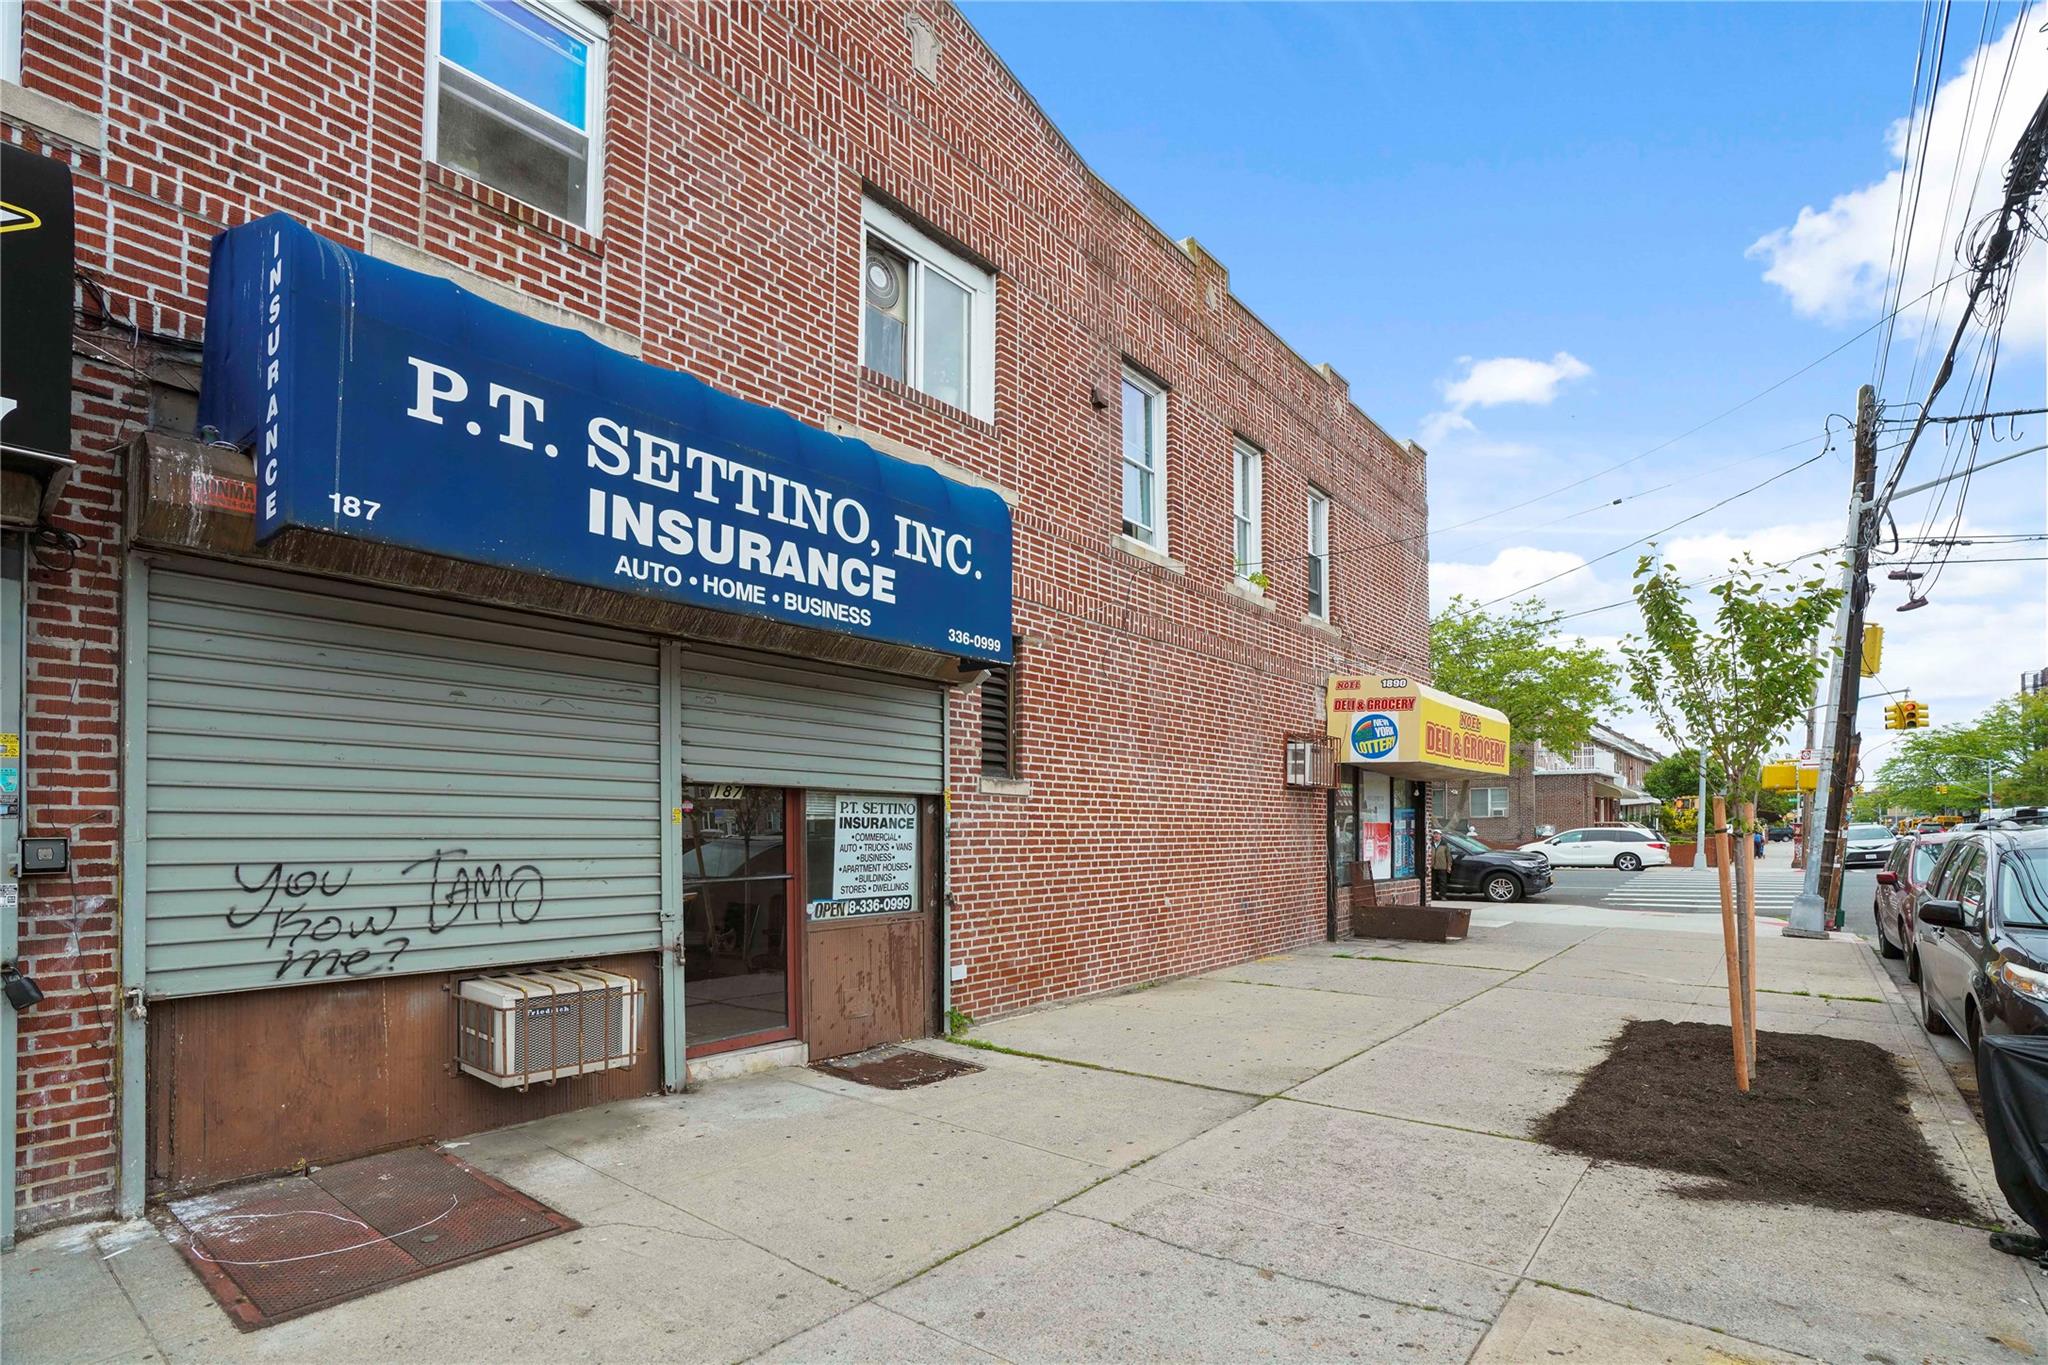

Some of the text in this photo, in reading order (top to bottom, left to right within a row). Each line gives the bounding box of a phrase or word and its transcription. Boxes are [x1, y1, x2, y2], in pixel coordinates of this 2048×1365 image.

[265, 231, 283, 521] INSURANCE
[407, 356, 983, 580] P.T. SETTINO, INC.
[328, 493, 381, 521] 187
[588, 488, 897, 604] INSURANCE
[614, 555, 872, 627] AUTO HOME BUSINESS
[948, 628, 1001, 652] 336-0999
[1336, 679, 1407, 690] NOEL 1890
[1333, 697, 1416, 712] DELI & GROCERY
[1373, 719, 1390, 727] NEW
[1459, 711, 1481, 732] NOEL
[1374, 727, 1395, 738] YORK
[1355, 736, 1396, 754] LOTTERY
[1426, 721, 1507, 768] DELI & GROCERY
[714, 785, 742, 798] 187
[840, 802, 916, 815] P.T. SETTINO
[839, 817, 915, 829] INSURANCE
[855, 833, 897, 842] COMMERCIAL
[840, 842, 913, 853] AUTO TRUCKS VANS
[860, 853, 892, 862] BUSINESS
[842, 863, 908, 873] APARTMENT HOUSES
[858, 874, 893, 883] BUILDINGS
[840, 882, 909, 894] STORES DWELLINGS
[814, 902, 846, 918] OPEN
[527, 1005, 569, 1017] Friedich
